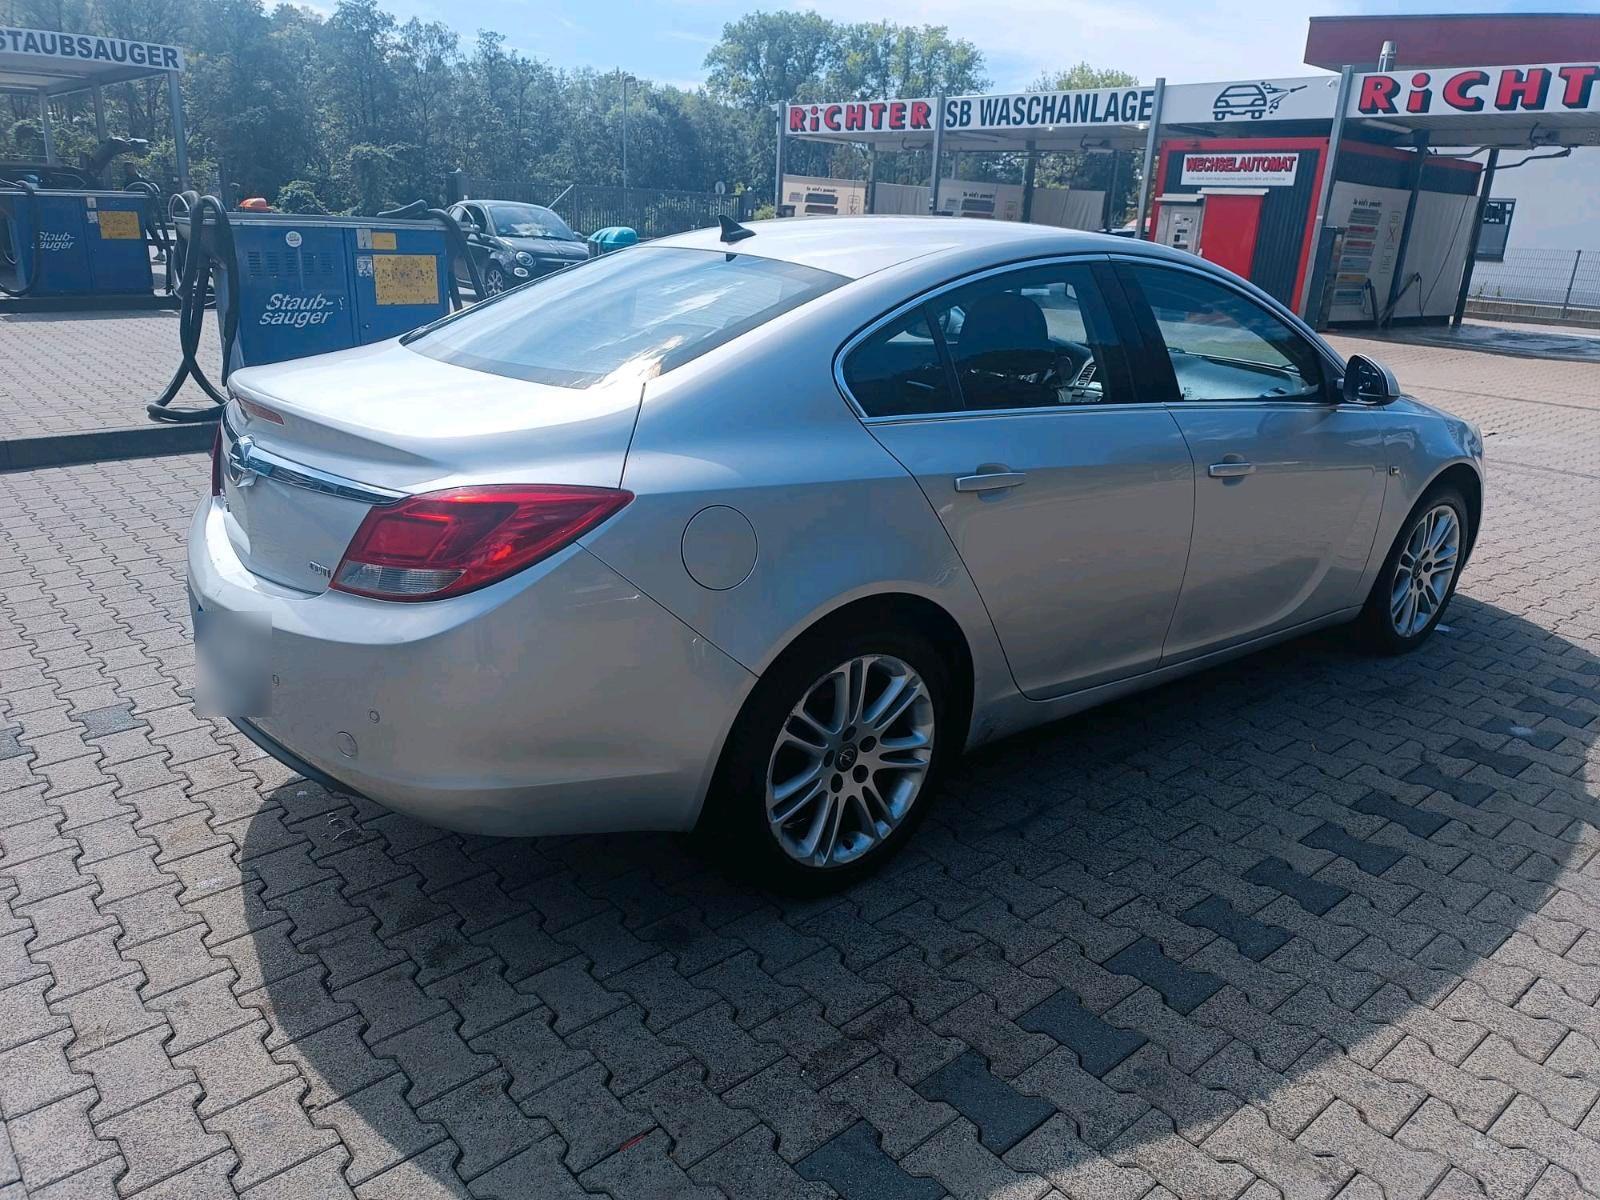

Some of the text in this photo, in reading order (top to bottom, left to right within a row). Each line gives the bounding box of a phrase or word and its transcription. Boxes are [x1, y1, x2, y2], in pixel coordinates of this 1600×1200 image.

[945, 91, 1154, 127] SB WASCHANLAGE
[1186, 156, 1296, 173] WECHSELAUTOMAT
[266, 293, 334, 311] Staub-
[259, 311, 333, 328] sauger
